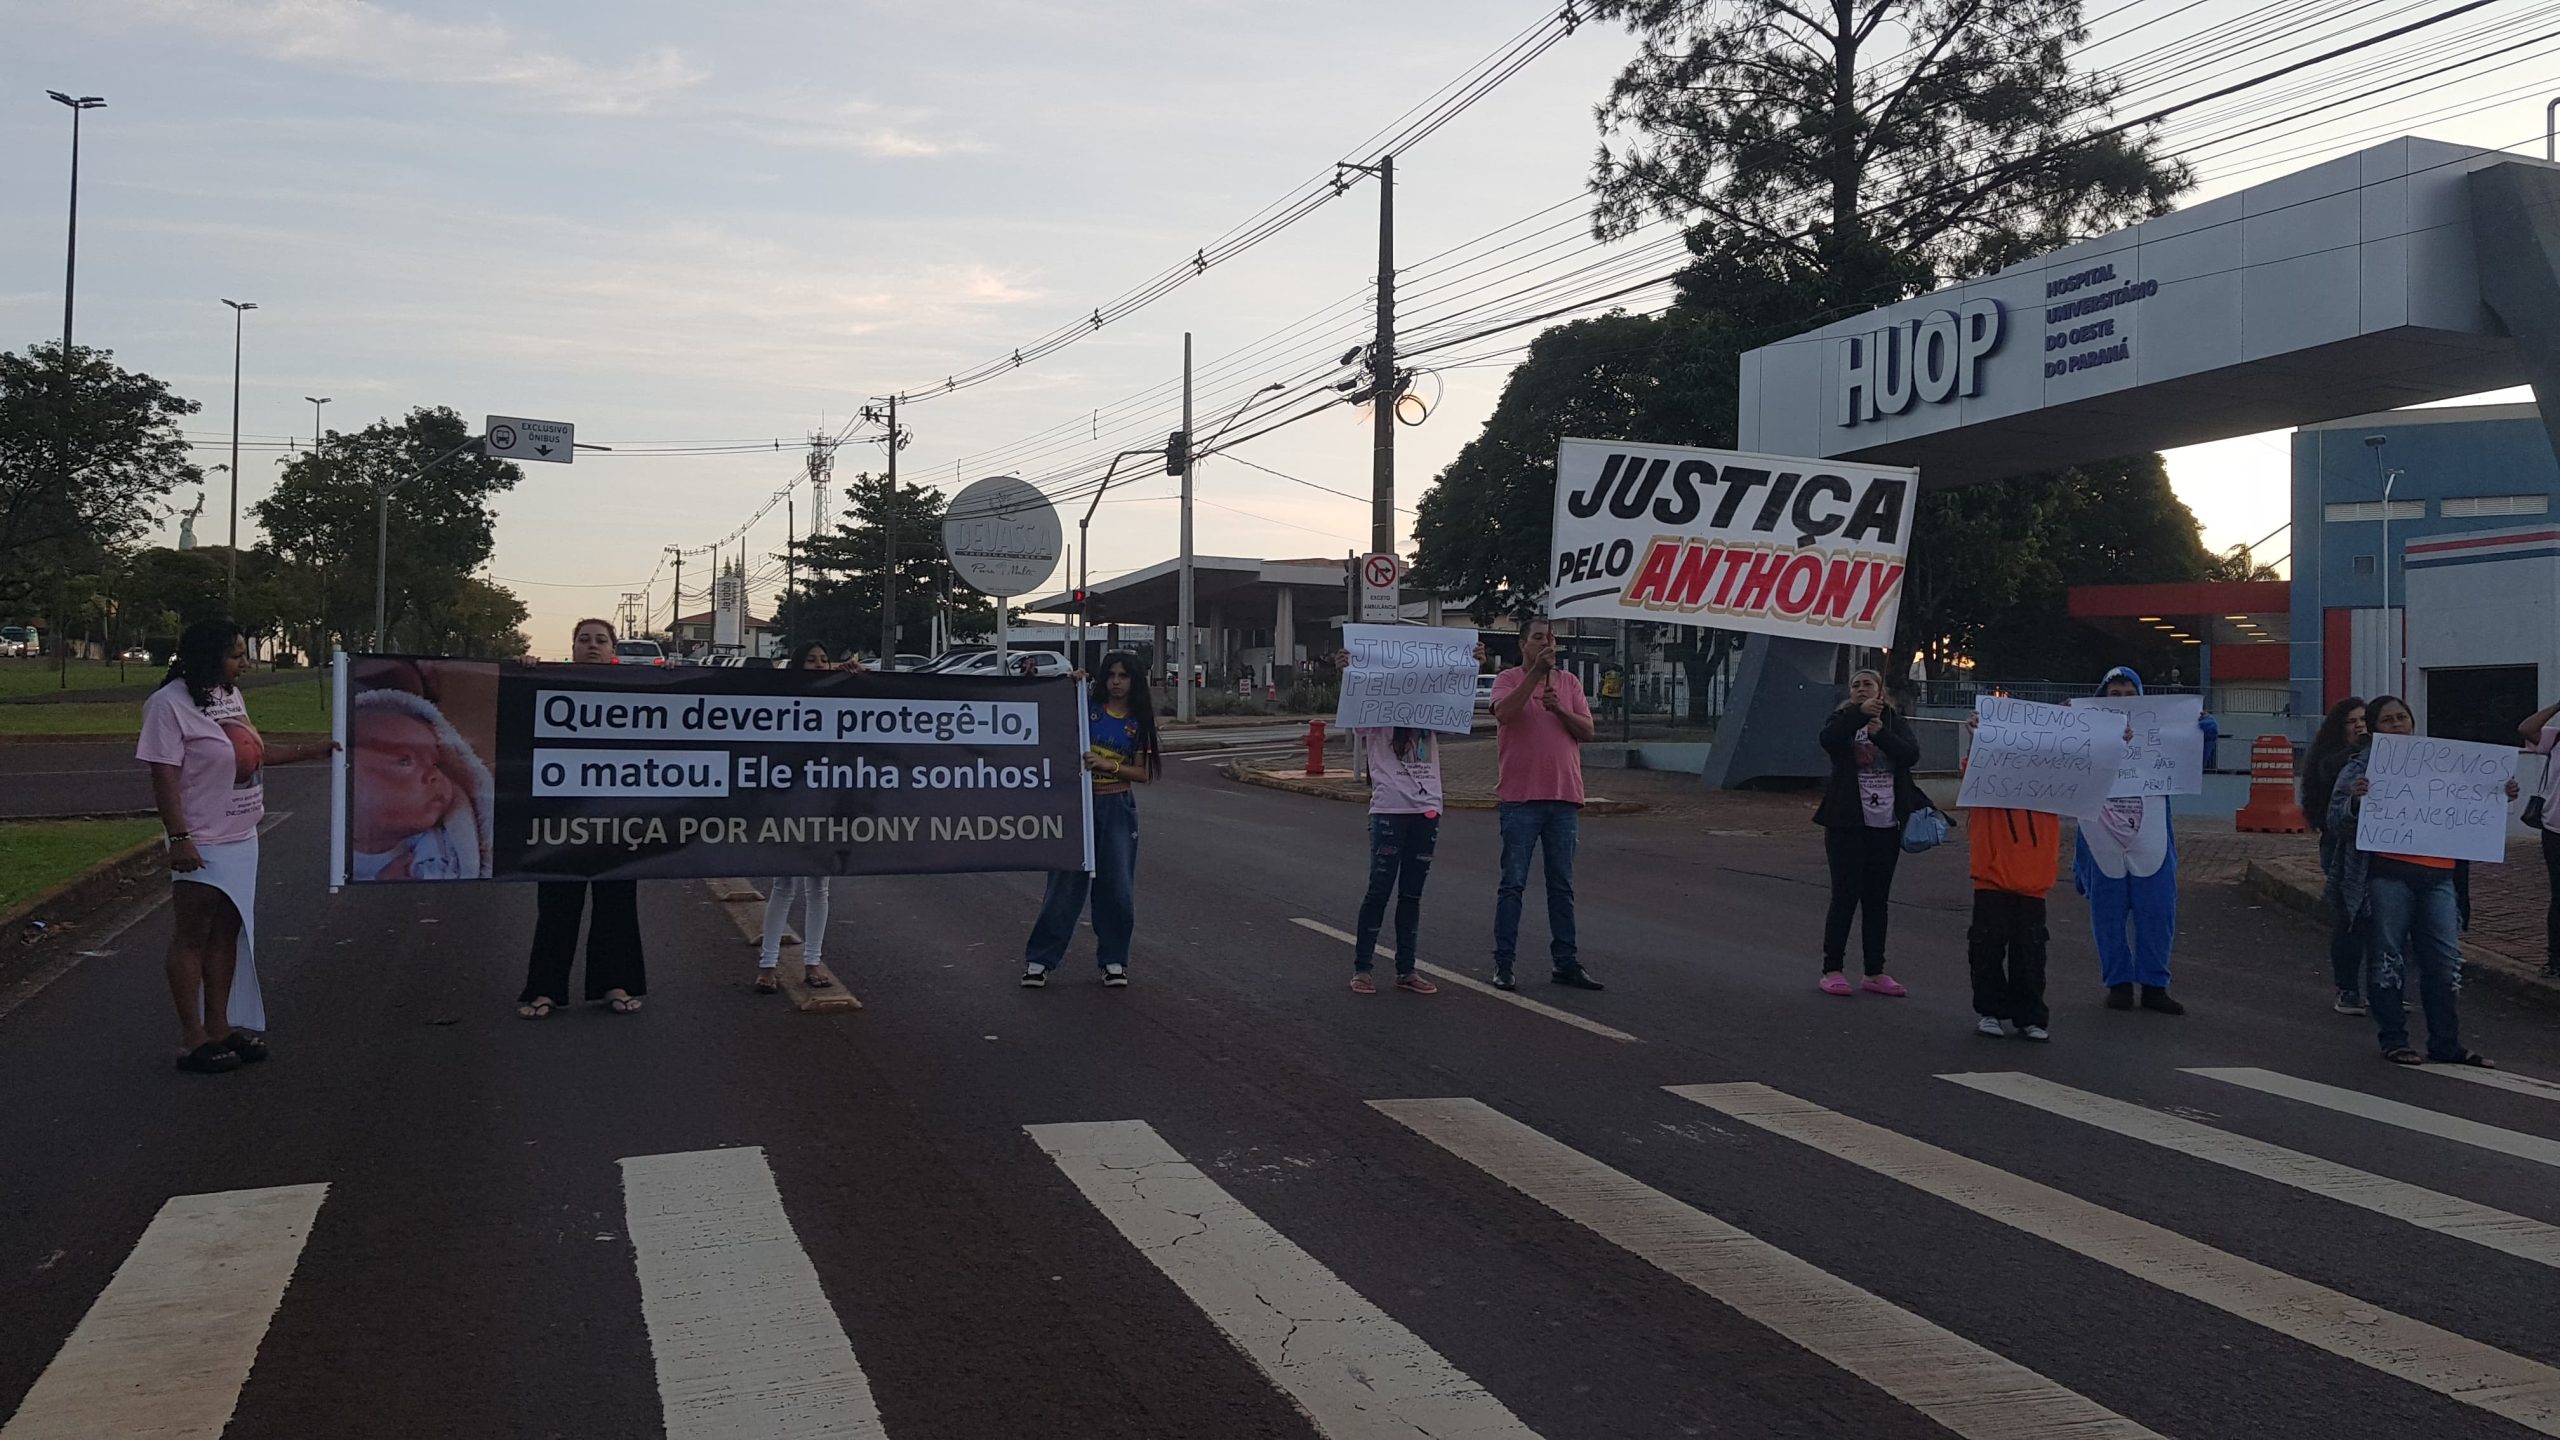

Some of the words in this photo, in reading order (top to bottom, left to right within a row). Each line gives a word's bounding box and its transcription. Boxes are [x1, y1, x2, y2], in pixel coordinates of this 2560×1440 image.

[2046, 264, 2116, 298] HOSPITAL
[2046, 279, 2158, 324] UNIVERSITÁRIO
[2046, 332, 2067, 351] DO
[2069, 318, 2114, 345] OESTE
[1837, 297, 2005, 427] HUOP
[2045, 359, 2066, 378] DO
[2069, 337, 2130, 372] PARANÁ
[521, 423, 568, 434] EXCLUSIVO
[529, 431, 560, 443] ÔNIBUS
[1567, 453, 1908, 548] JUSTIÇA
[1554, 538, 1634, 588] PELO
[1621, 535, 1905, 630] ANTHONY
[1347, 671, 1418, 697] PELO
[1420, 672, 1477, 697] MEU
[543, 695, 668, 732] Quem
[682, 698, 823, 733] deveria
[836, 703, 1032, 740] protegê-lo,
[1359, 699, 1473, 727] PEQUENO
[1981, 698, 2090, 732] QUEREMOS
[1979, 723, 2091, 757] JUSTIÇA
[540, 762, 566, 787] o
[580, 757, 723, 788] matou.
[737, 757, 792, 788] Ele
[804, 755, 899, 789] tinha
[911, 757, 1052, 789] sonhos!
[526, 817, 668, 850] JUSTIÇA
[679, 817, 748, 844] POR
[758, 815, 920, 843] ANTHONY
[930, 814, 1064, 841] NADSON
